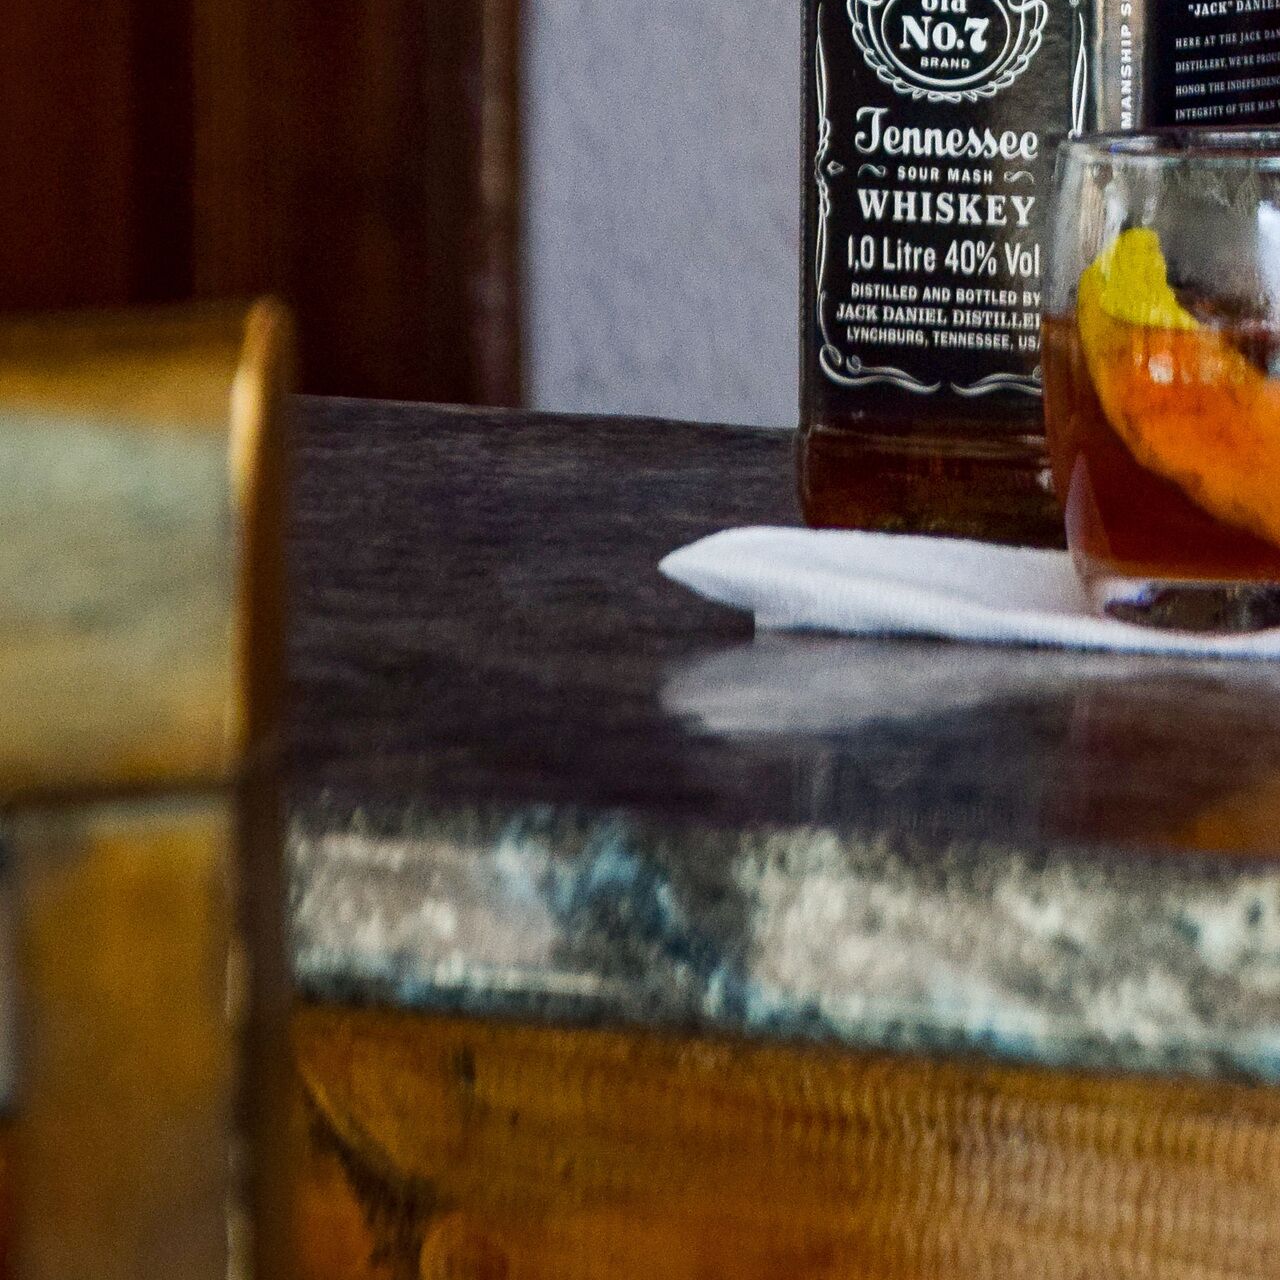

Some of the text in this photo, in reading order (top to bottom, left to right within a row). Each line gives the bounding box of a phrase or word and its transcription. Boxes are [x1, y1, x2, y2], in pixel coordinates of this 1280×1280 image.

[900, 15, 990, 53] No.7
[1204, 34, 1216, 46] AT
[1219, 33, 1237, 45] THE
[1240, 30, 1261, 46] JACK
[920, 56, 970, 70] BRAND
[1120, 23, 1133, 130] MANSHIP
[1208, 81, 1225, 94] THE
[1240, 101, 1255, 114] THE
[855, 106, 1039, 160] Tennessee
[897, 165, 994, 184] SOUR MASH
[857, 189, 1036, 228] WHISKEY
[882, 236, 936, 274] Litre
[944, 238, 997, 276] 40%
[851, 283, 1040, 306] DISTILLED AND BOTTLED BY
[836, 302, 1041, 329] JACK DANIEL DISTILLE
[846, 326, 928, 347] LYNCHBURG,
[933, 330, 1014, 350] TENNESSEE,
